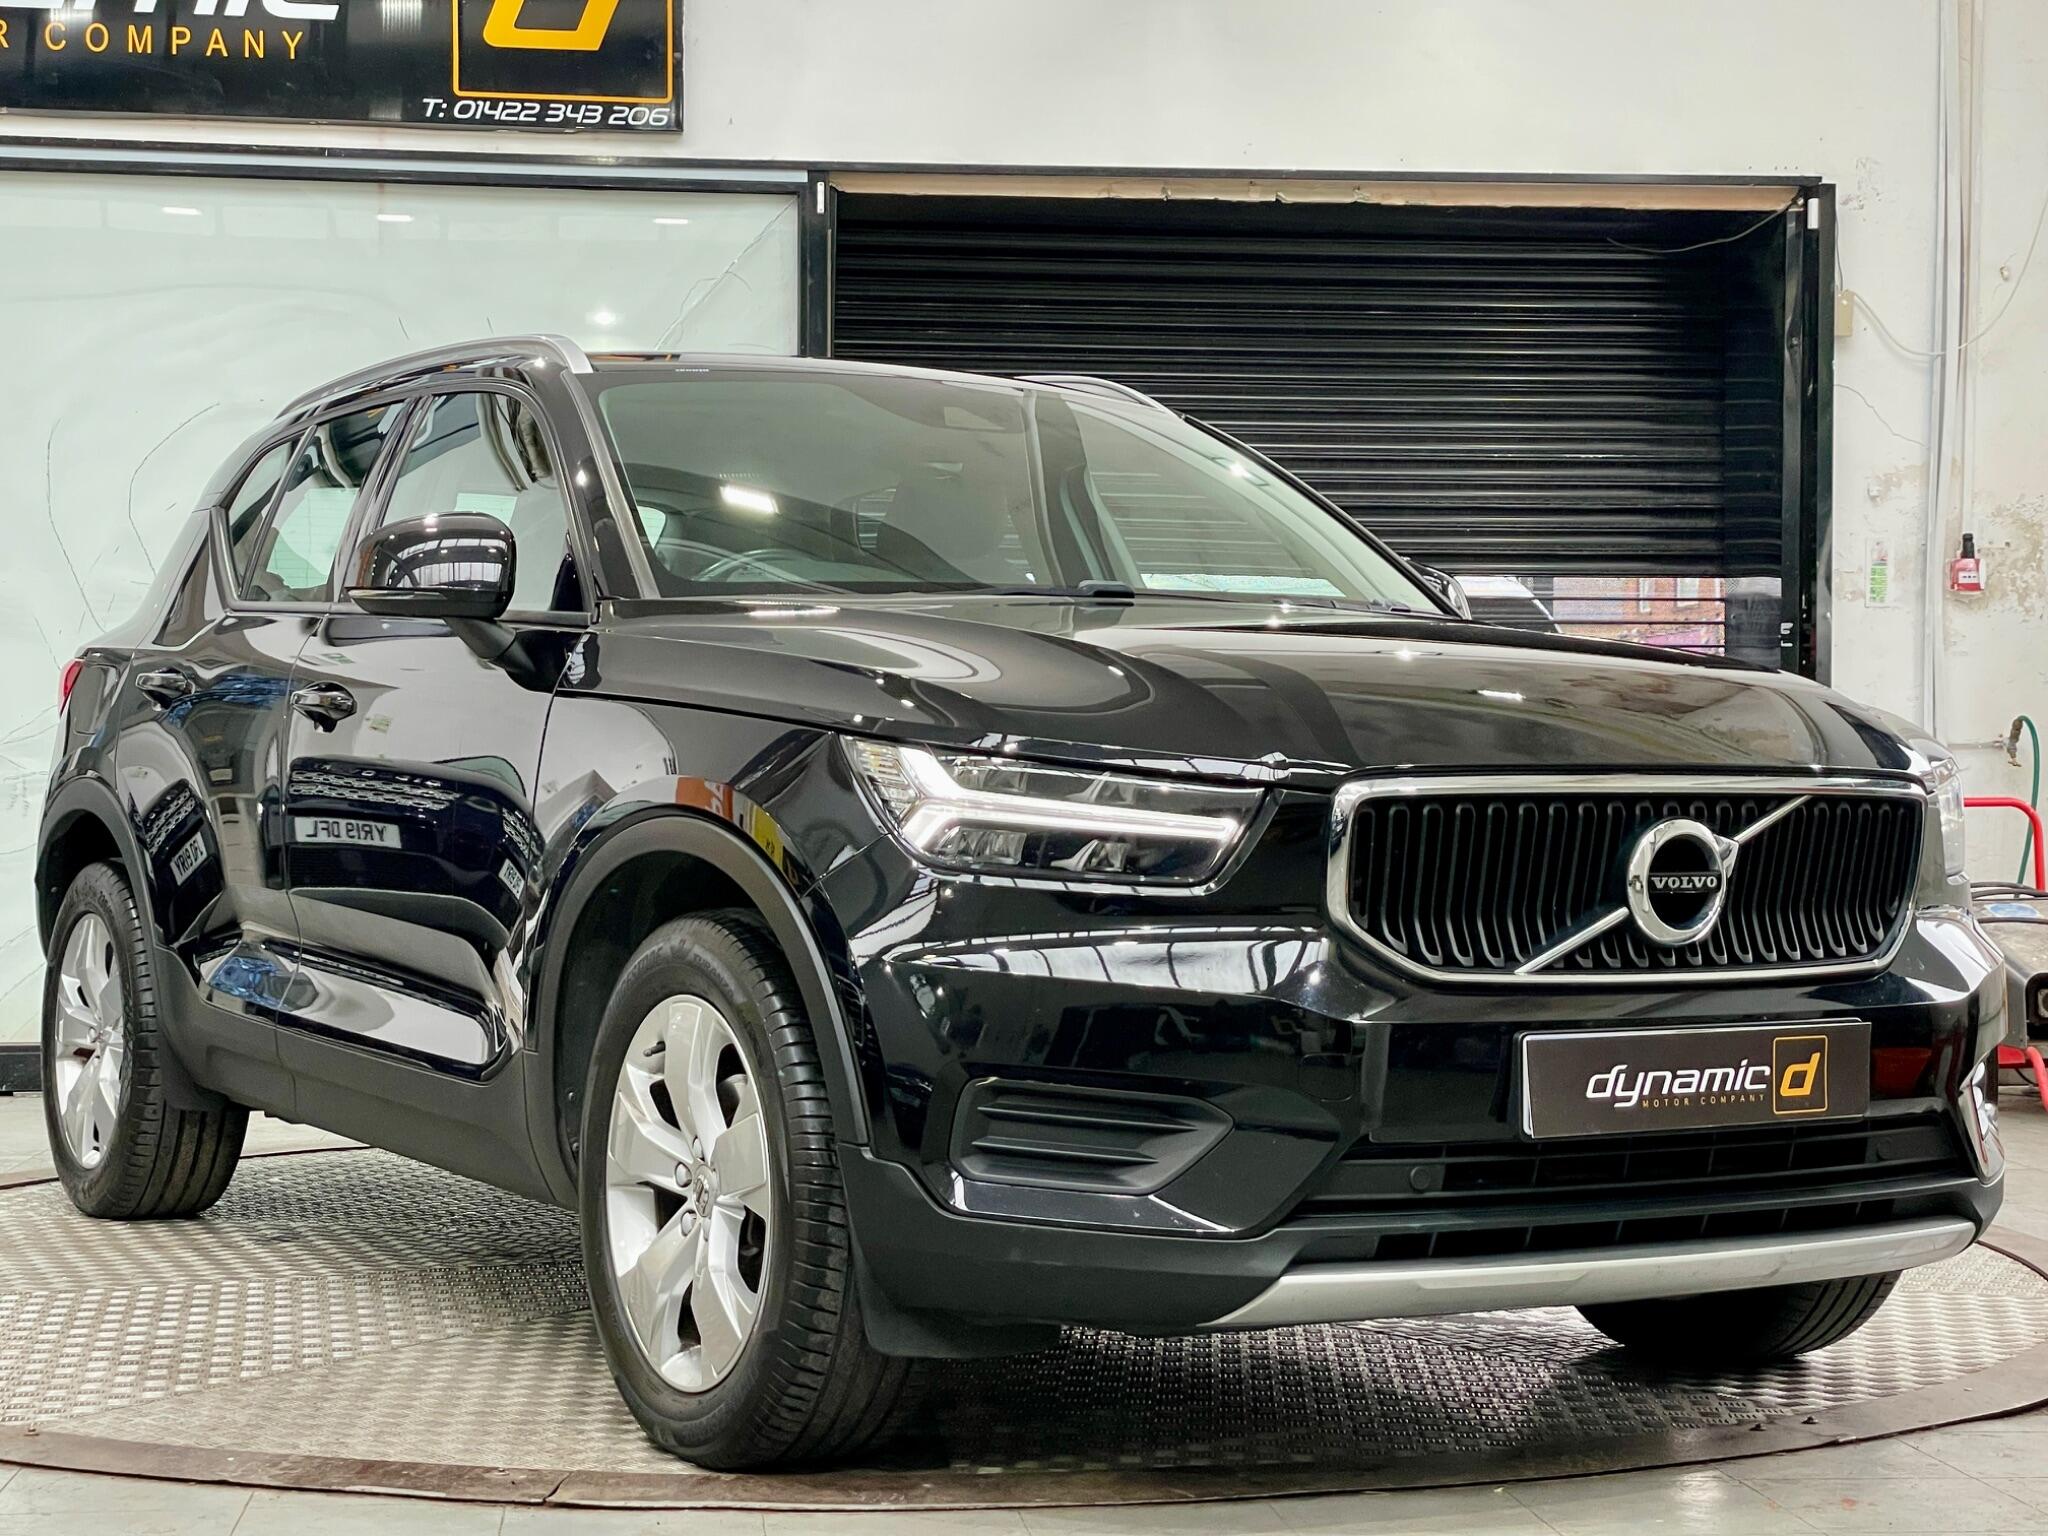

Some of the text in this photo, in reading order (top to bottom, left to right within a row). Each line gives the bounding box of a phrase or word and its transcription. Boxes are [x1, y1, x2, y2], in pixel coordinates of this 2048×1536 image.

[44, 22, 304, 60] COMPANY
[423, 98, 671, 126] T: 01422 343 206
[1651, 876, 1718, 889] VOLVO
[1586, 1058, 1771, 1108] dynamic
[1642, 1093, 1765, 1109] MOTOR COMPANY
